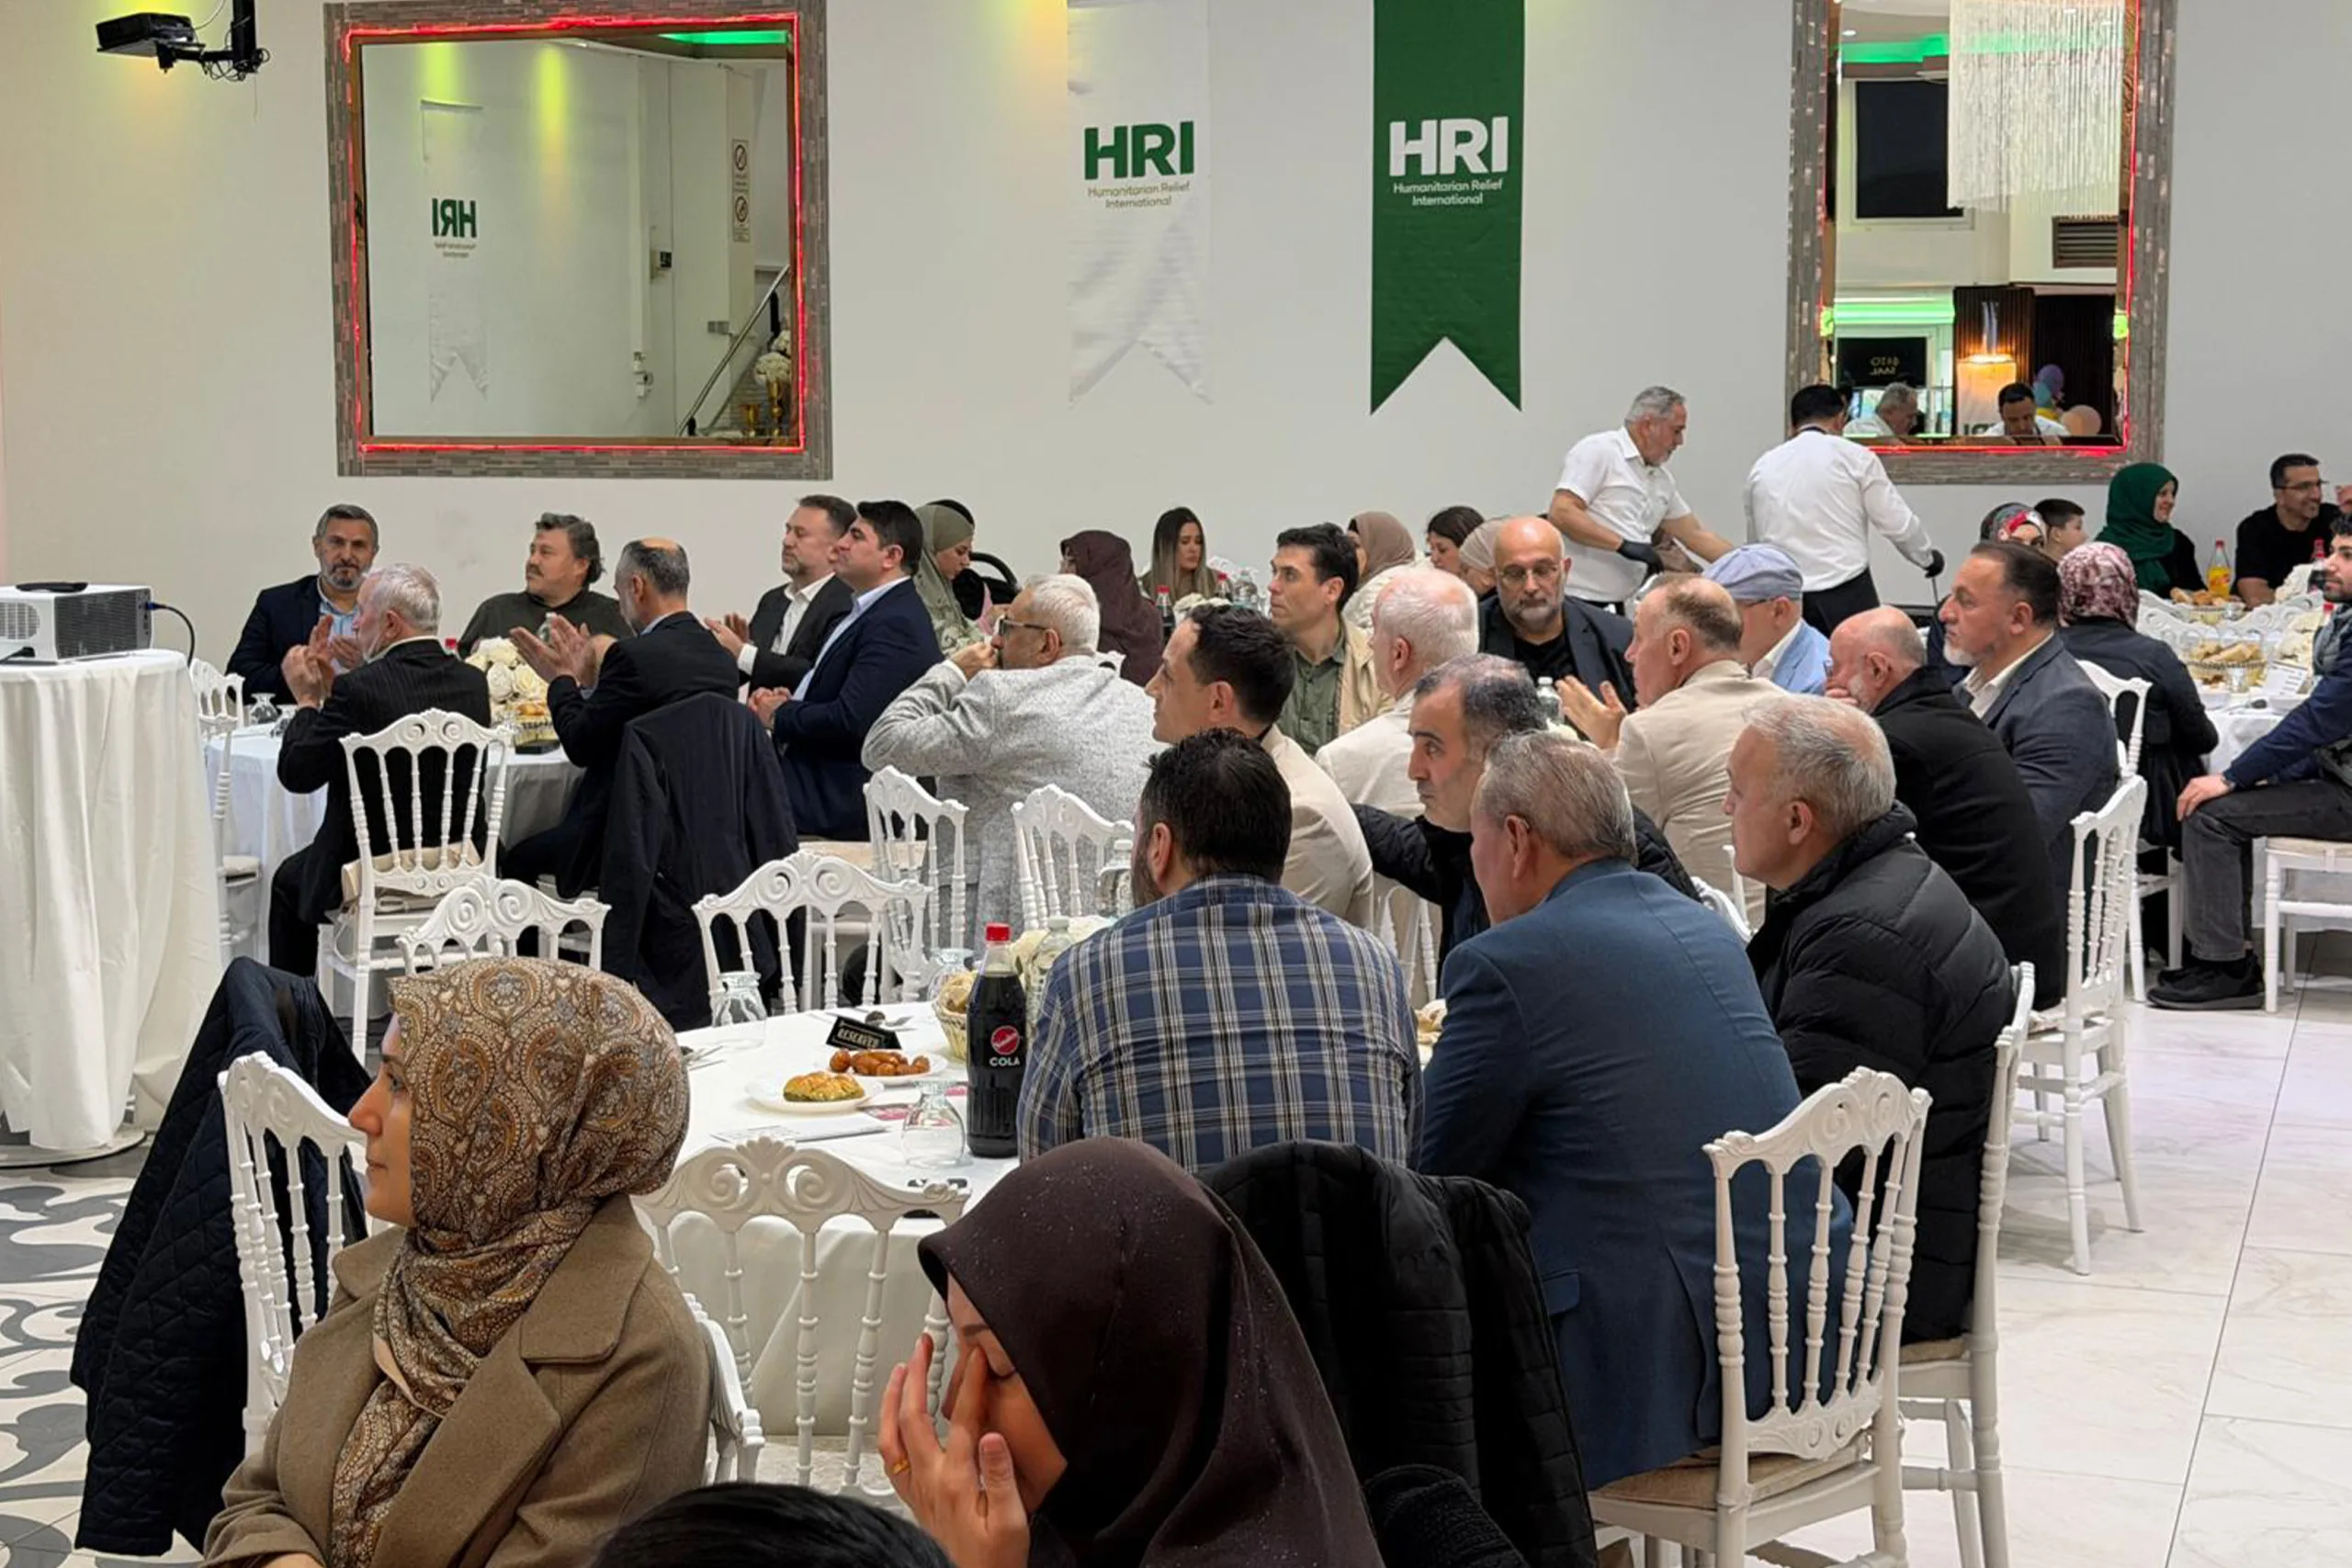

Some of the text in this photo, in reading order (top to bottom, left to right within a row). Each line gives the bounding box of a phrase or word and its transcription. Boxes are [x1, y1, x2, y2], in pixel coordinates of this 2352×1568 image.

[1084, 120, 1194, 180] HRI
[1389, 116, 1509, 176] HRI
[1087, 181, 1191, 197] Humanitarian Relief
[1393, 178, 1503, 194] Humanitarian Relief
[1104, 195, 1172, 209] International
[1411, 192, 1484, 207] International
[989, 1056, 1021, 1067] COLA
